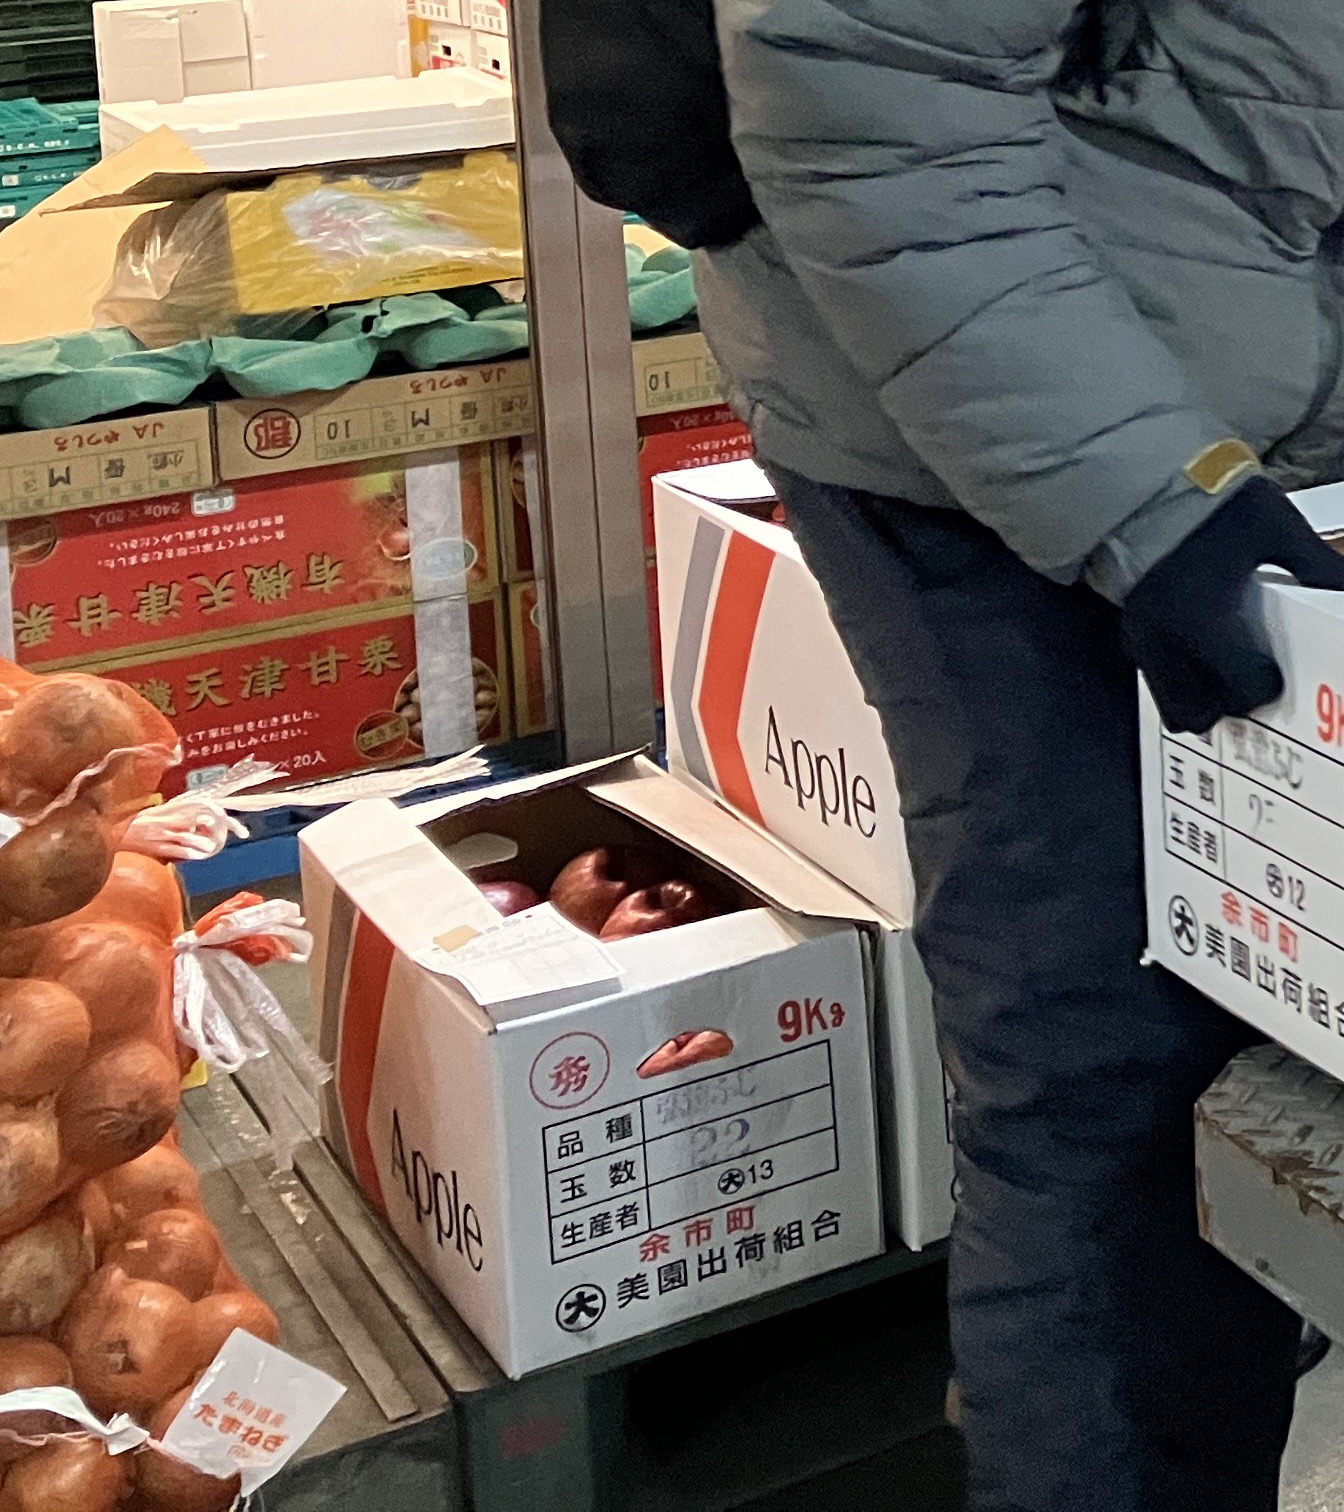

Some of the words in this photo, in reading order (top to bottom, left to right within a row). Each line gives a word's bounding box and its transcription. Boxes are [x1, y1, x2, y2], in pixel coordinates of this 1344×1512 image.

[410, 374, 469, 395] やつしろ
[477, 366, 507, 385] JA
[648, 371, 671, 392] 10
[54, 429, 121, 452] やつしろ
[133, 421, 165, 440] JA
[254, 415, 293, 451] 郡
[410, 407, 431, 429] M
[49, 463, 72, 487] M
[764, 705, 877, 839] Apple
[1168, 755, 1218, 807] 玉数
[1168, 811, 1219, 865] 生産者
[1221, 890, 1300, 963] 余市町
[777, 998, 847, 1043] 9Kg
[557, 1113, 634, 1160] 品種
[390, 1109, 484, 1273] Apple
[560, 1159, 636, 1203] 玉数
[561, 1202, 640, 1249] 生産者
[639, 1205, 756, 1263] 余市町
[617, 1209, 841, 1309] 美園出荷組合
